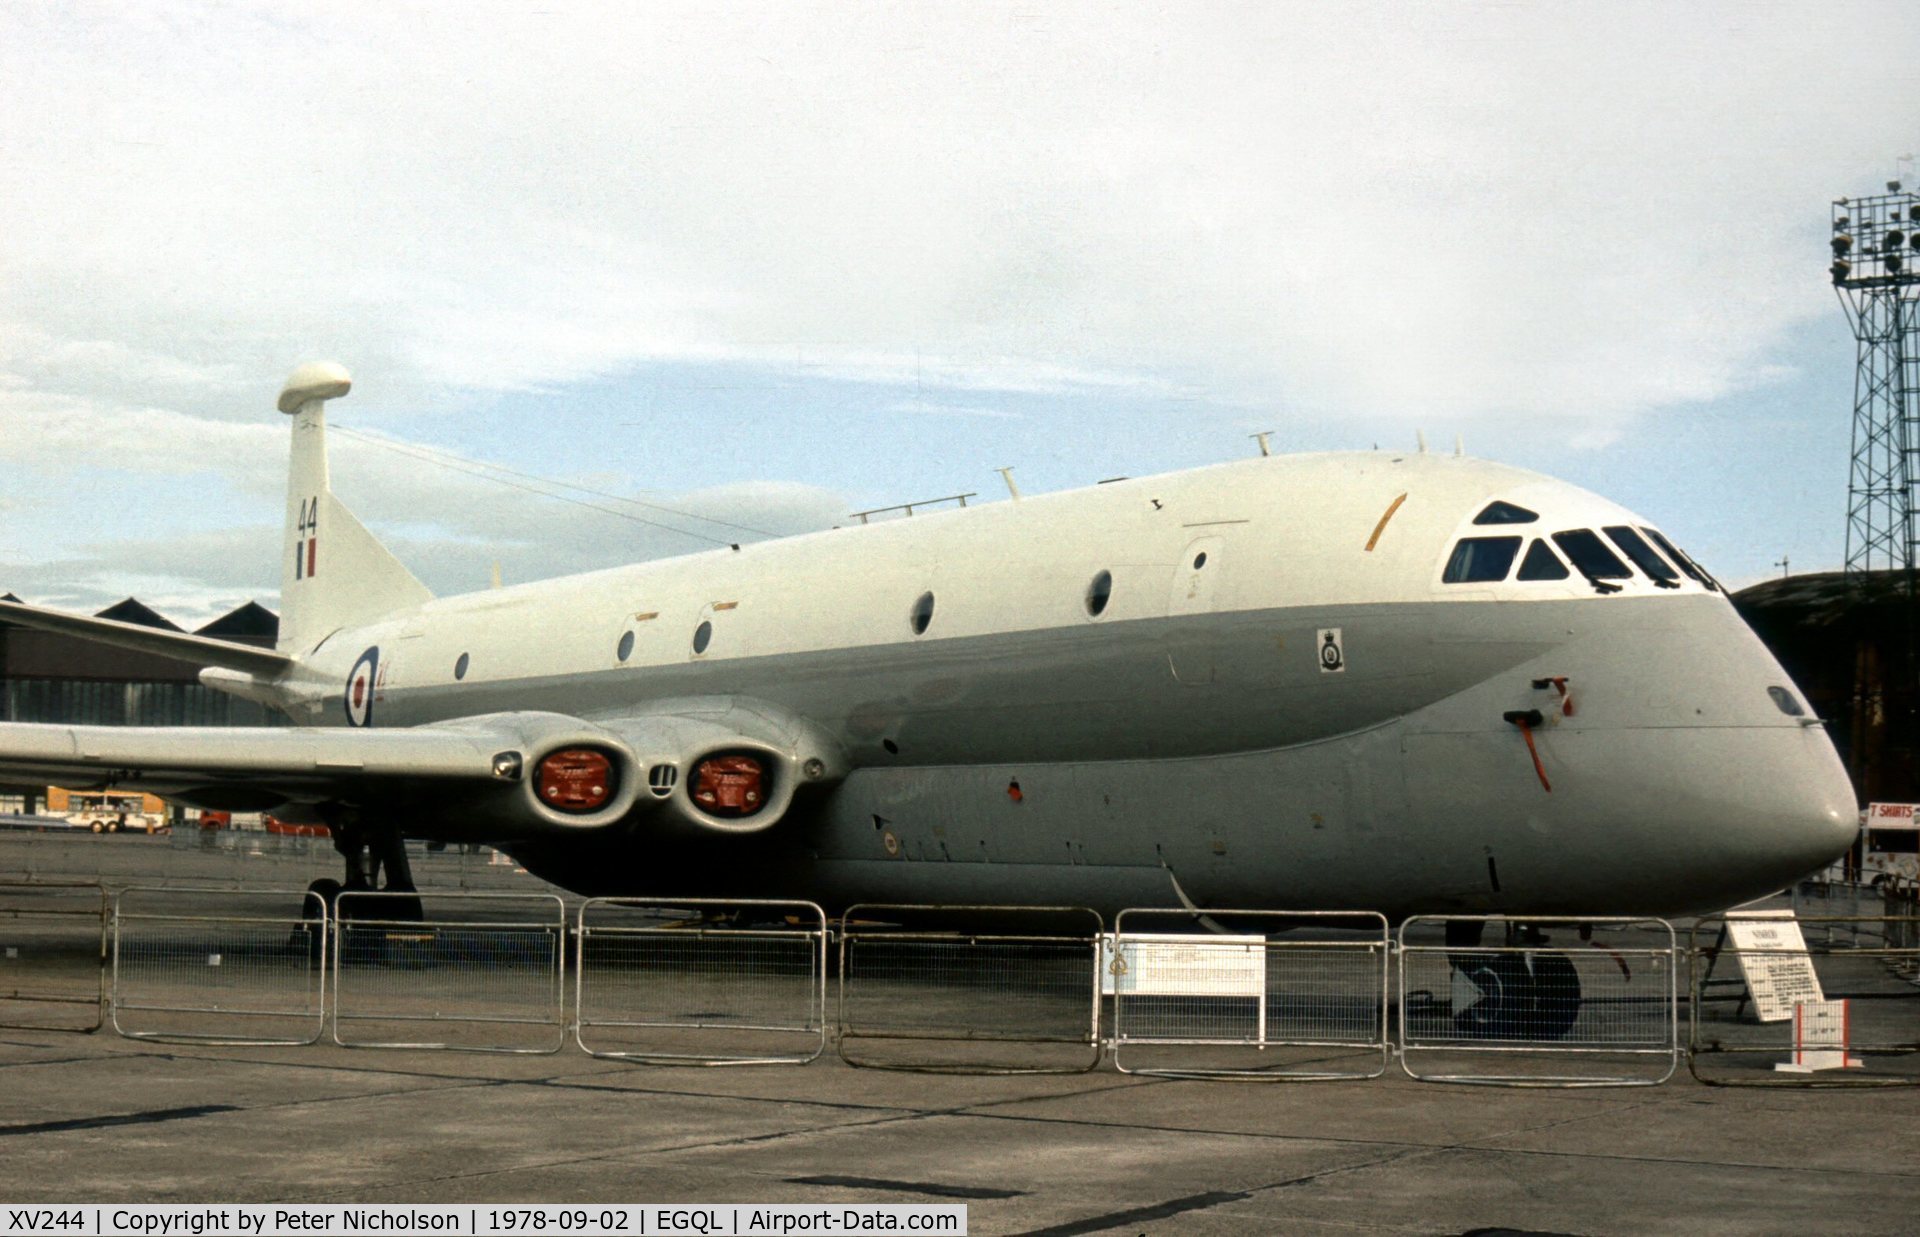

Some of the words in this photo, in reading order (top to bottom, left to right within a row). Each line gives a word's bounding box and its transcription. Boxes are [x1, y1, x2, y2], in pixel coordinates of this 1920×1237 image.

[298, 496, 317, 538] 44
[1871, 804, 1877, 817] T
[1879, 804, 1912, 818] SHIRTS
